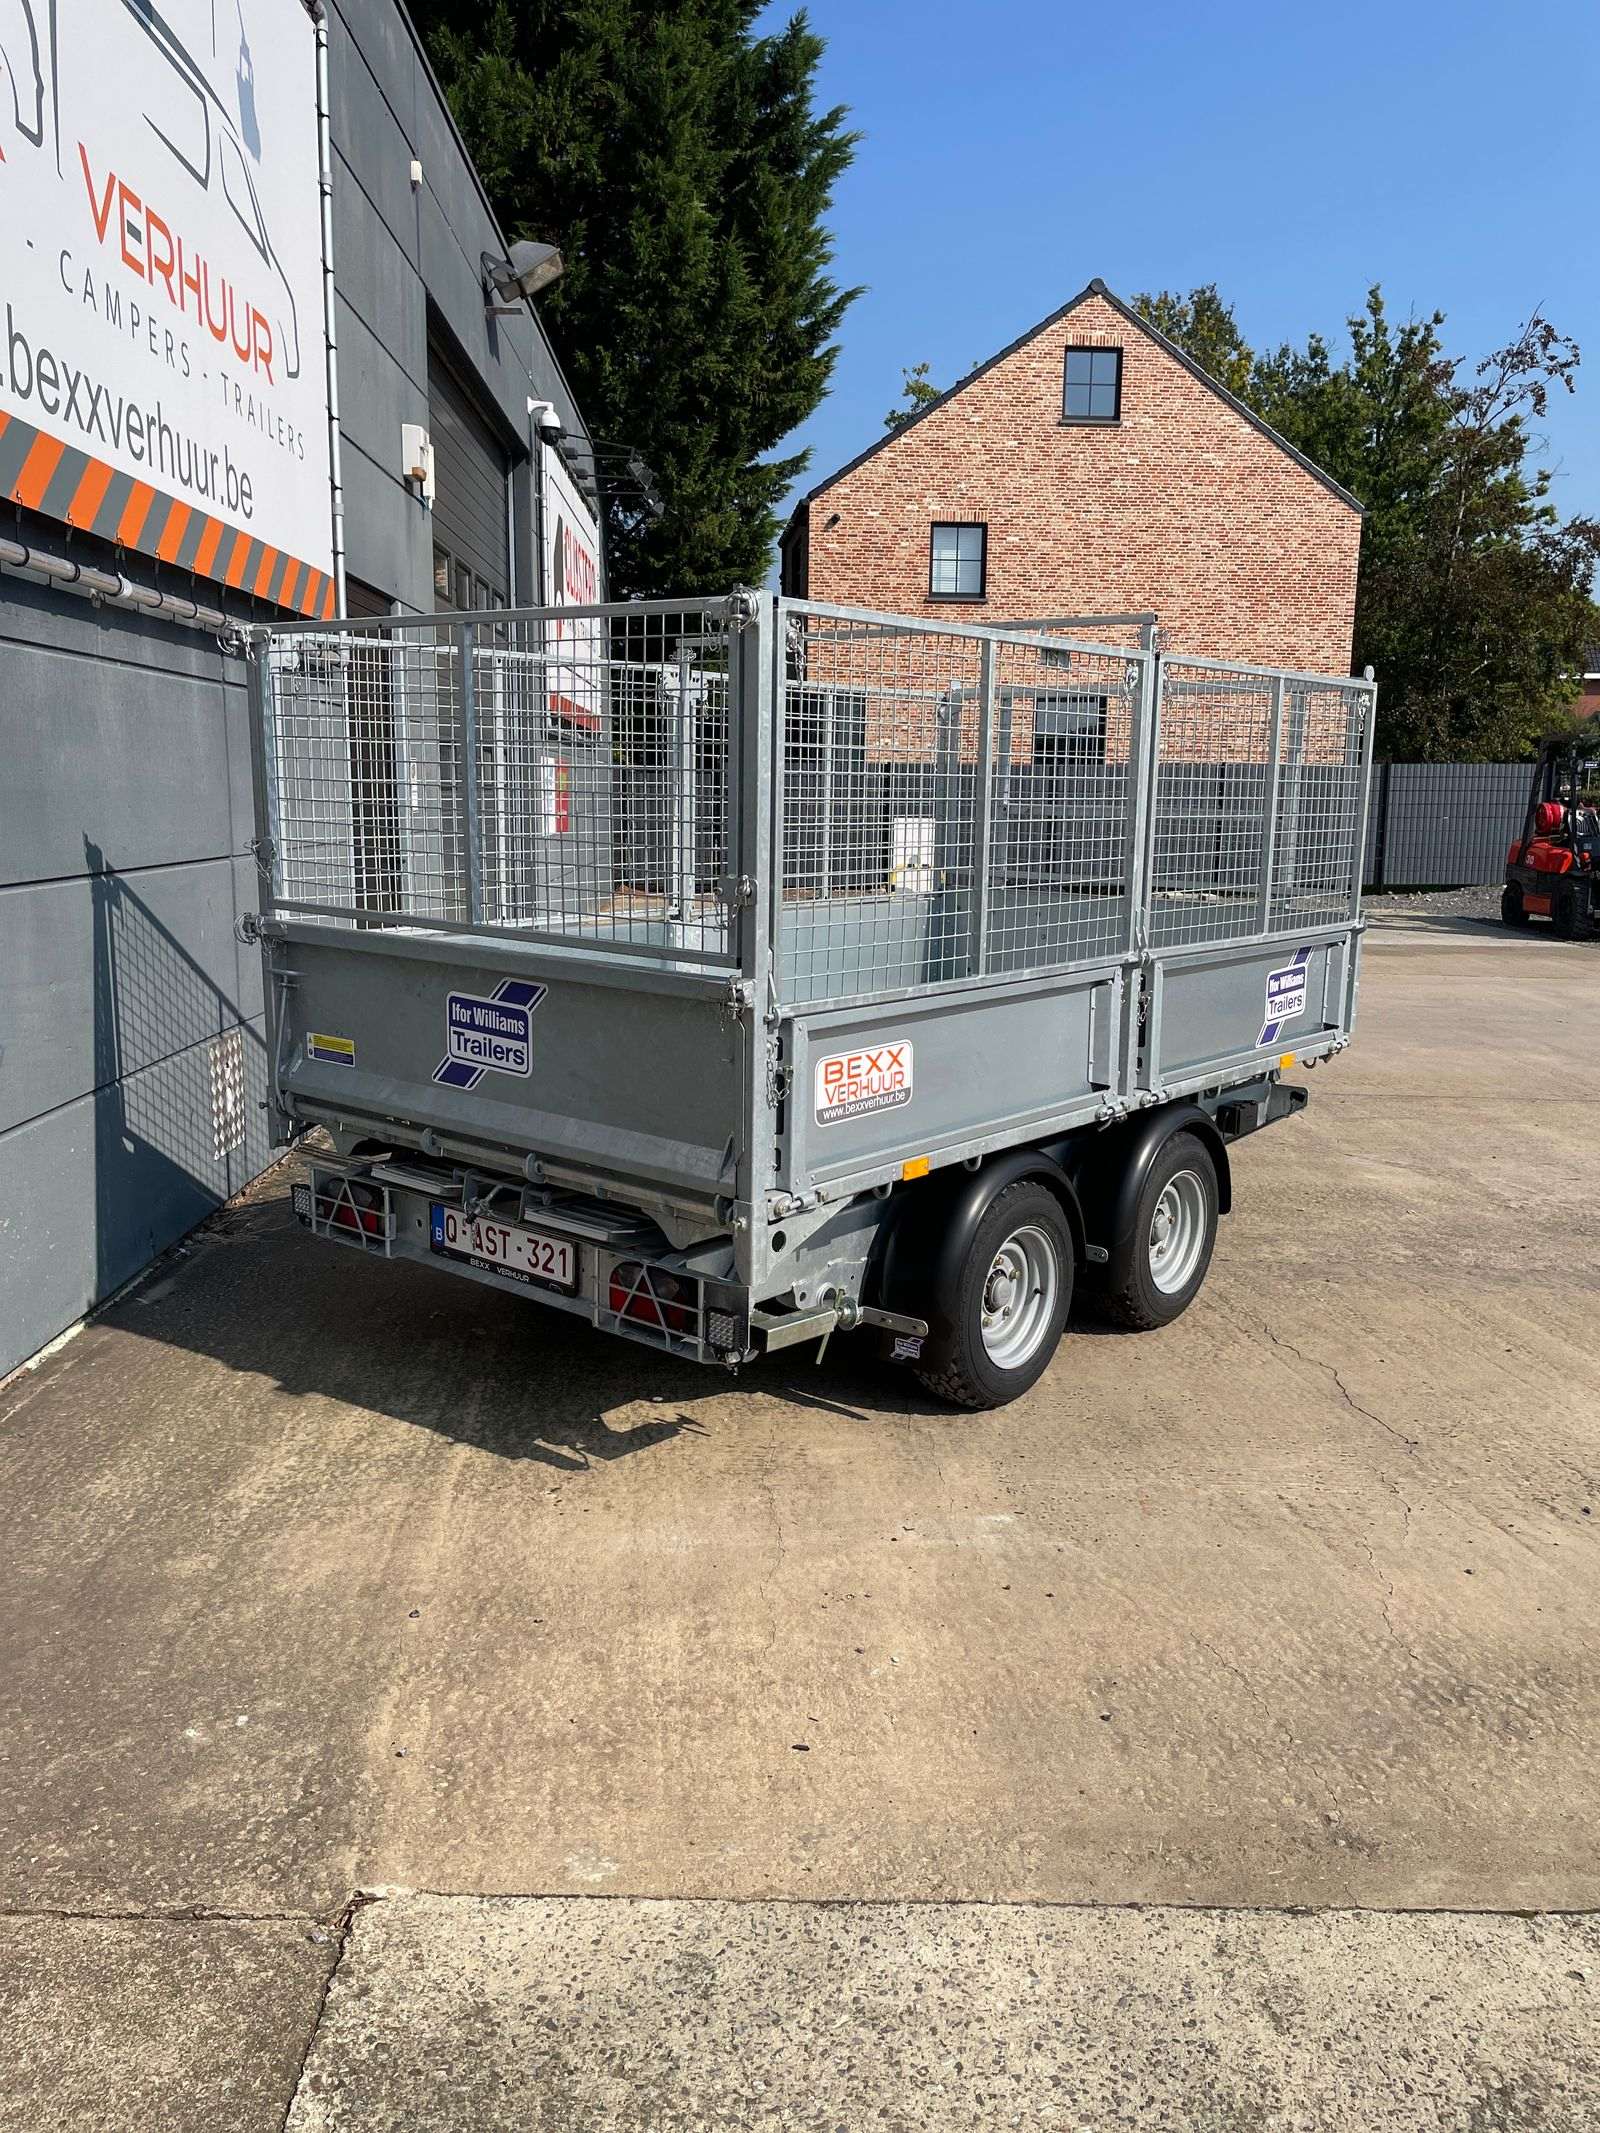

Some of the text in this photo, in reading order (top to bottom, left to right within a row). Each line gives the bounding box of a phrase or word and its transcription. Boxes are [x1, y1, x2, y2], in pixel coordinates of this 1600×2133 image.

[78, 141, 274, 386] VERHUUR
[60, 249, 305, 461] CAMPERS TRAILERS
[452, 1002, 525, 1035] Ifor Williams
[1268, 994, 1303, 1015] Trailers
[452, 1030, 526, 1066] Trailers
[824, 1046, 905, 1085] BEXX
[824, 1070, 905, 1105] VERHUUR
[822, 1090, 906, 1120] www.bexxverhuur.be
[434, 1226, 443, 1241] B
[470, 1257, 531, 1284] BEXX VERHUUR
